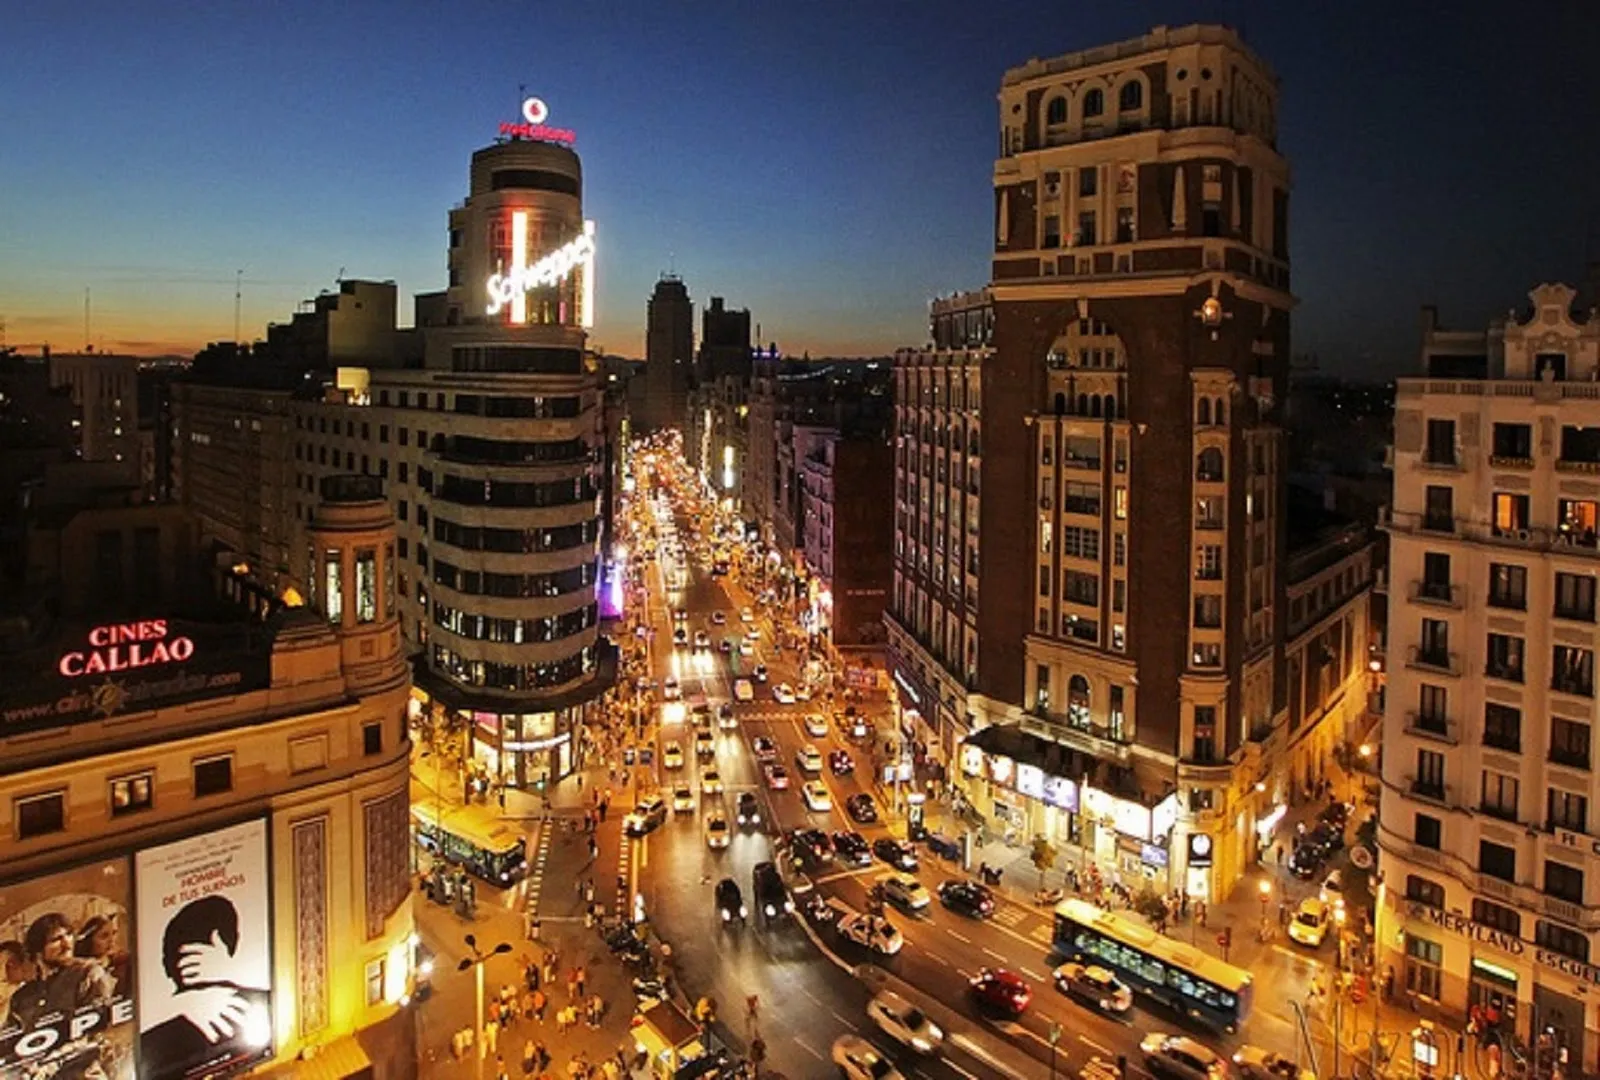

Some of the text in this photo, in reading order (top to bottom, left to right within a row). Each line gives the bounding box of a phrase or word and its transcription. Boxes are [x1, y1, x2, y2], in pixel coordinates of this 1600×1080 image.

[88, 619, 168, 647] CINES
[59, 637, 194, 676] CALLAO
[162, 894, 176, 908] DE
[1429, 906, 1524, 955] MERYLAND
[0, 999, 133, 1065] OPE
